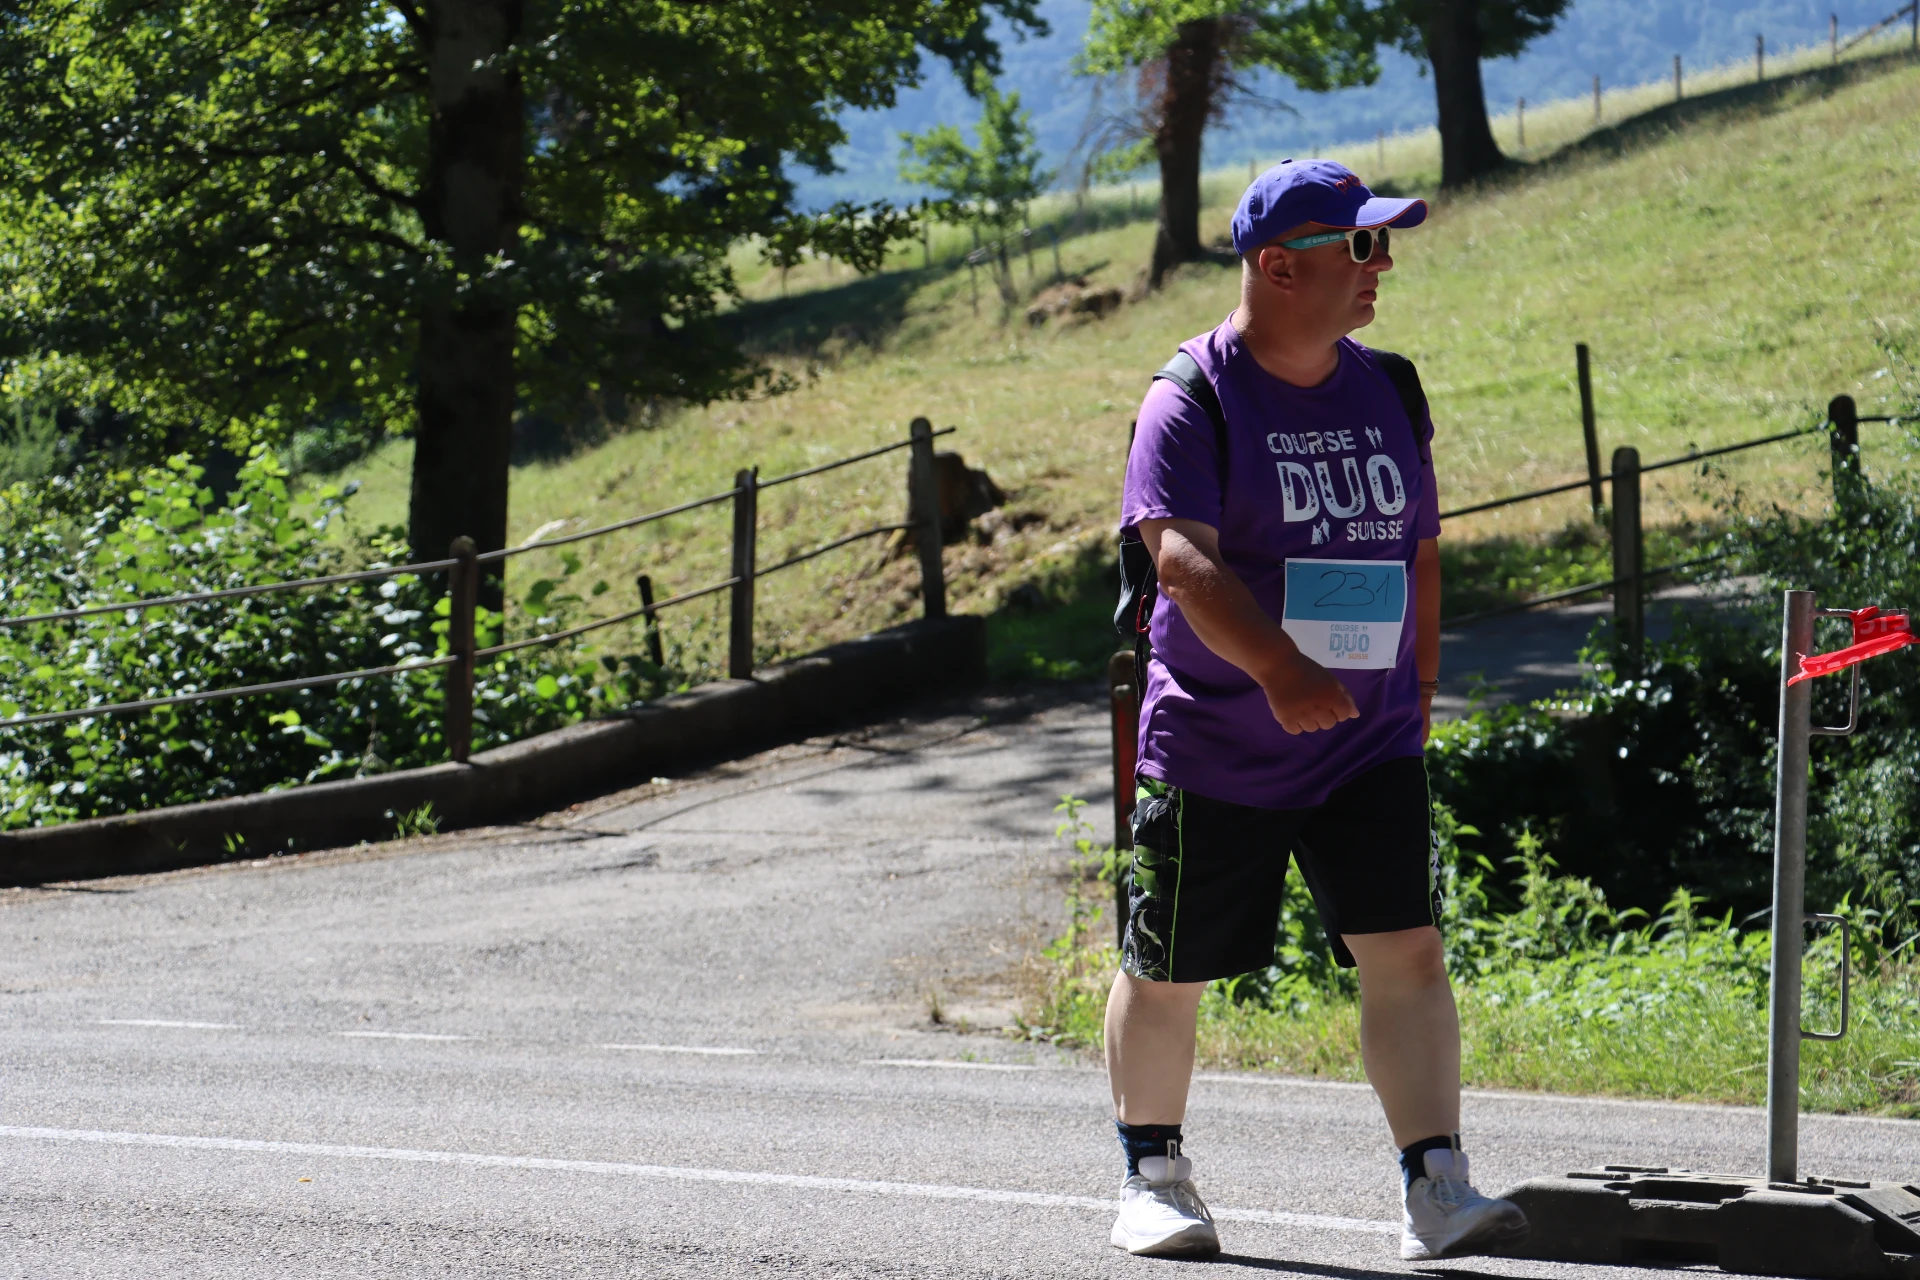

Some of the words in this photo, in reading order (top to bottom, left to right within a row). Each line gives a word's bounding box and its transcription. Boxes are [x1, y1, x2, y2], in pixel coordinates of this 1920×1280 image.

[1266, 429, 1357, 455] COURSE
[1276, 454, 1406, 522] DUO
[1346, 520, 1404, 542] SUISSE
[1314, 570, 1390, 607] 231
[1330, 624, 1360, 632] COURSE
[1329, 633, 1370, 652] DUO
